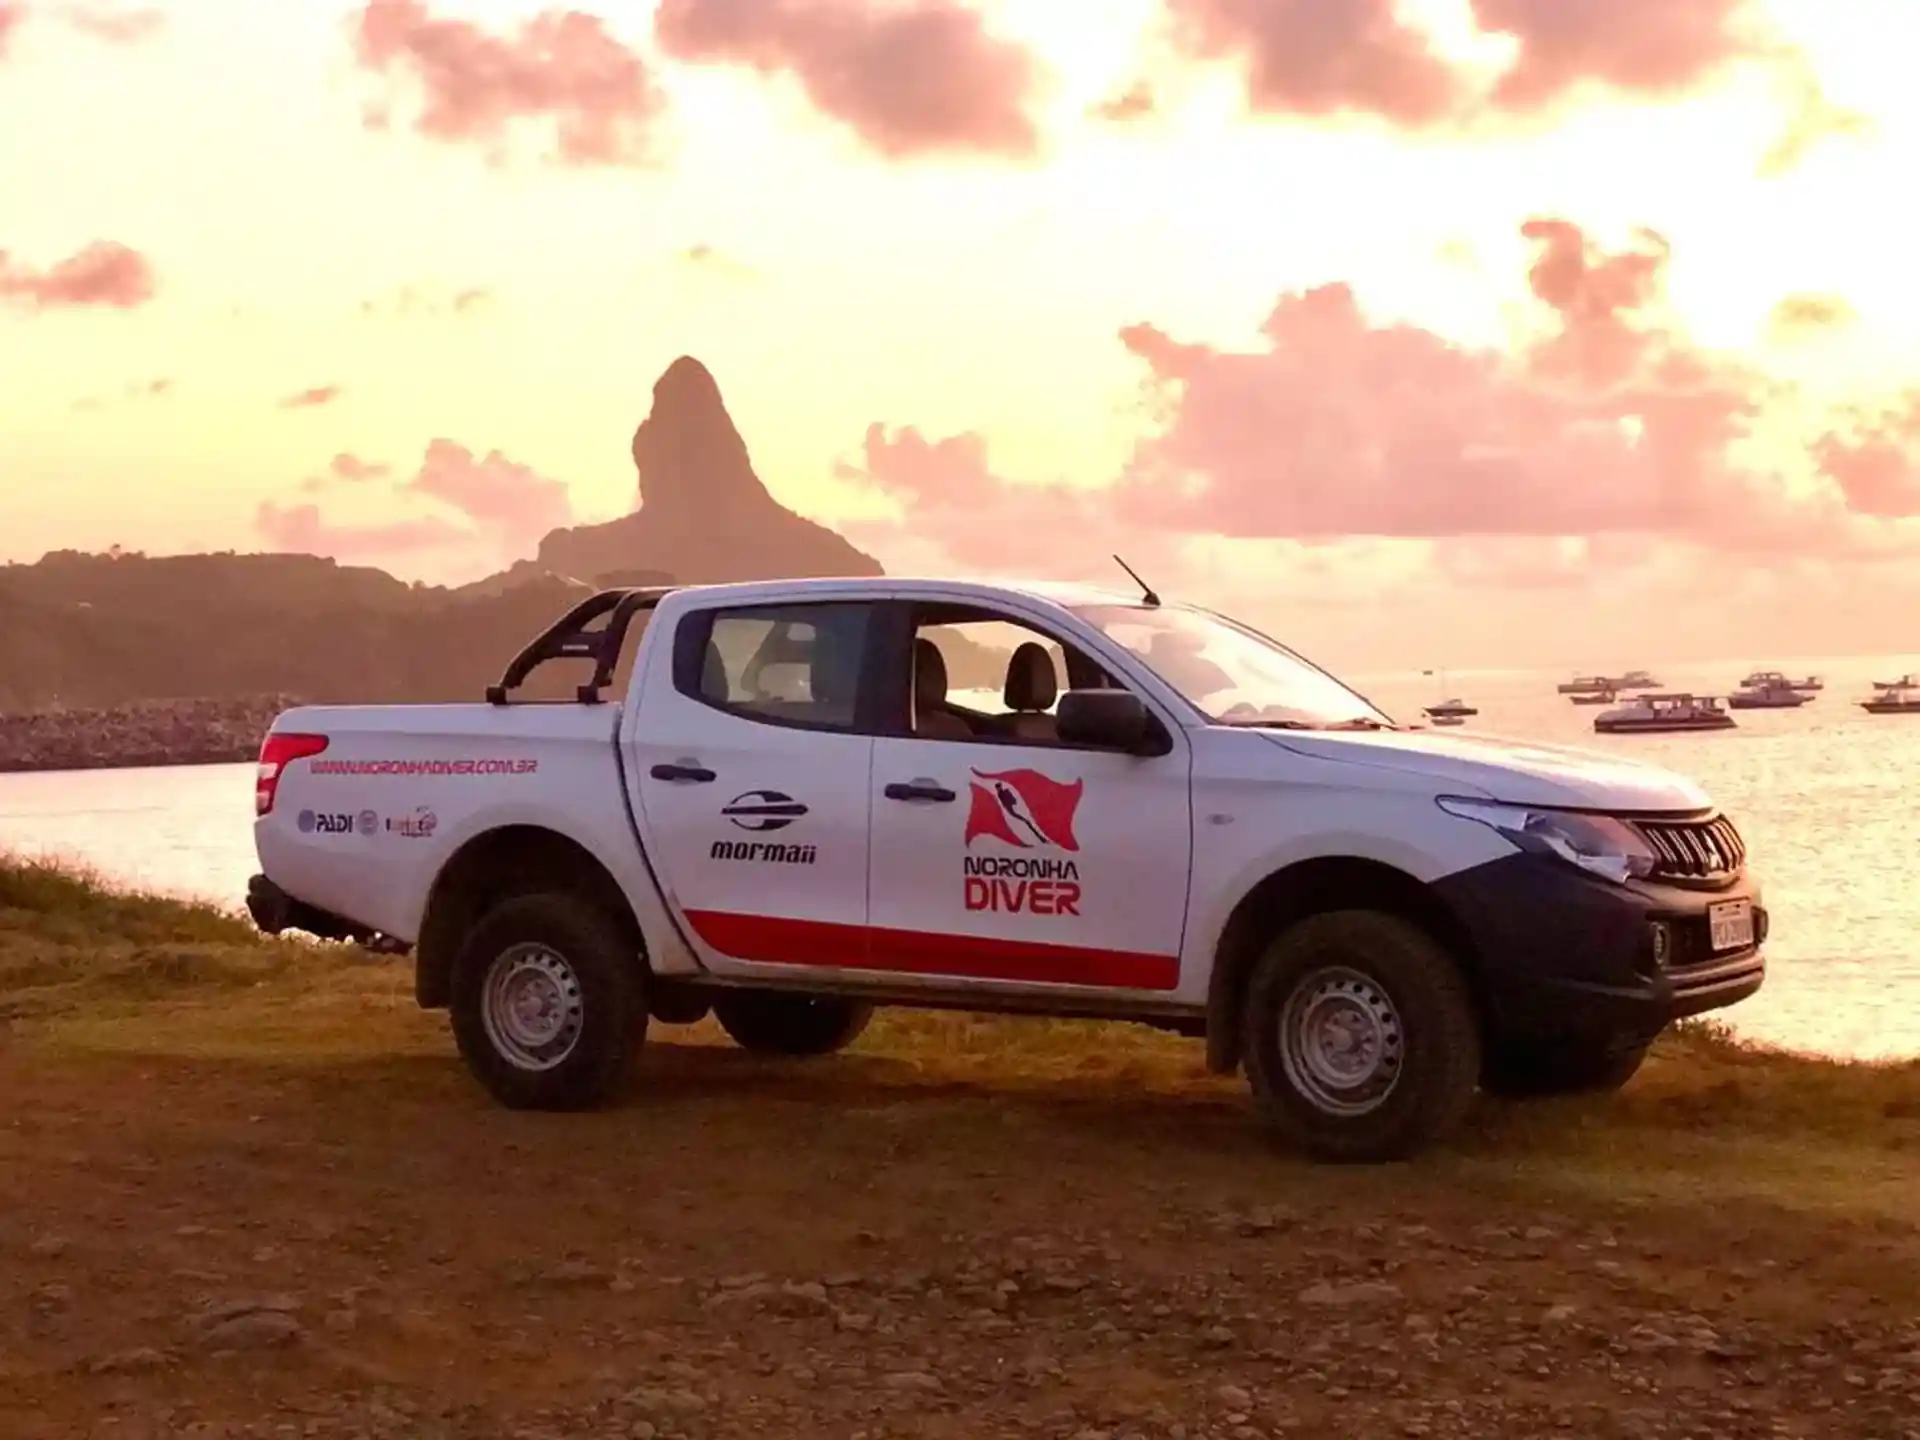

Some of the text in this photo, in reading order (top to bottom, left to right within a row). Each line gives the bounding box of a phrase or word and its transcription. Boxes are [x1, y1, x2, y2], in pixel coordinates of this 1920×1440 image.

[316, 813, 352, 833] PADI
[710, 840, 816, 865] mormaii
[964, 856, 1080, 880] NORONHA
[964, 877, 1081, 916] DIVER
